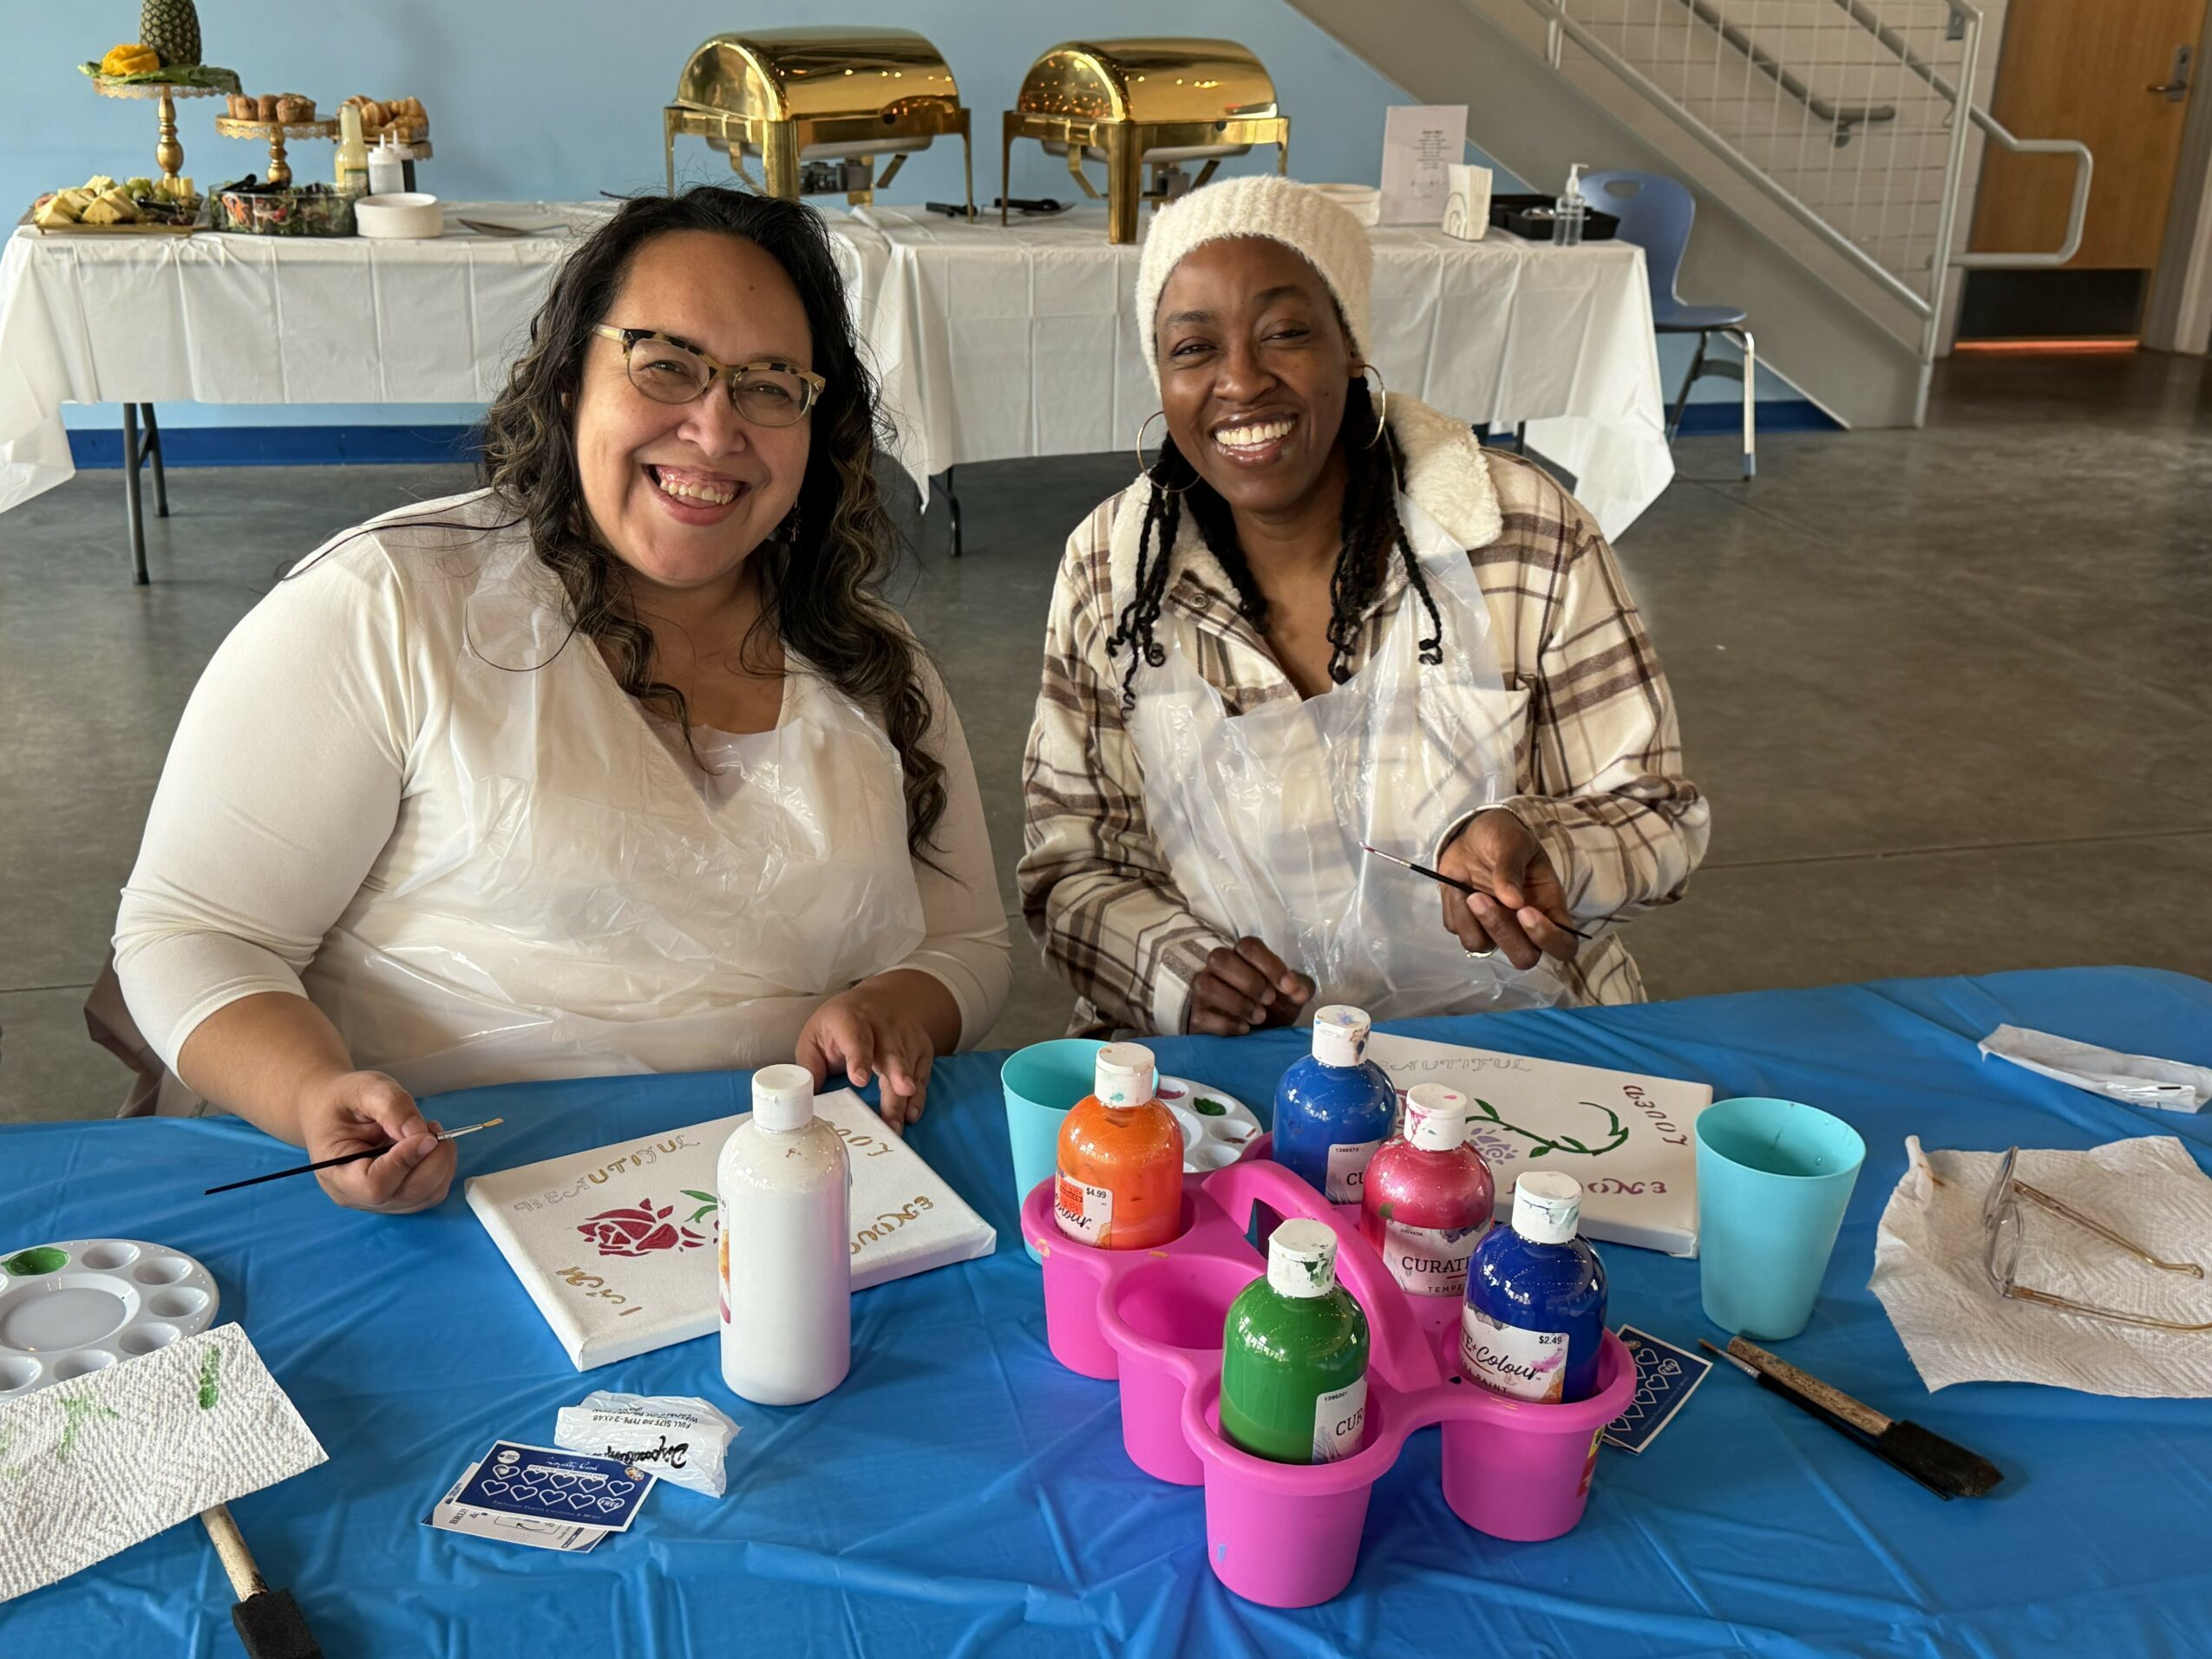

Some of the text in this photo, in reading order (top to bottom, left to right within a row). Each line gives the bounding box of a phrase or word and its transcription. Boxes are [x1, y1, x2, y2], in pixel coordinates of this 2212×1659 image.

[514, 1134, 701, 1212] BEAUTIFUL
[1086, 1187, 1107, 1199] $4.99
[1539, 1336, 1562, 1344] $2.49
[674, 1420, 691, 1429] FULL
[599, 1499, 620, 1508] FREE
